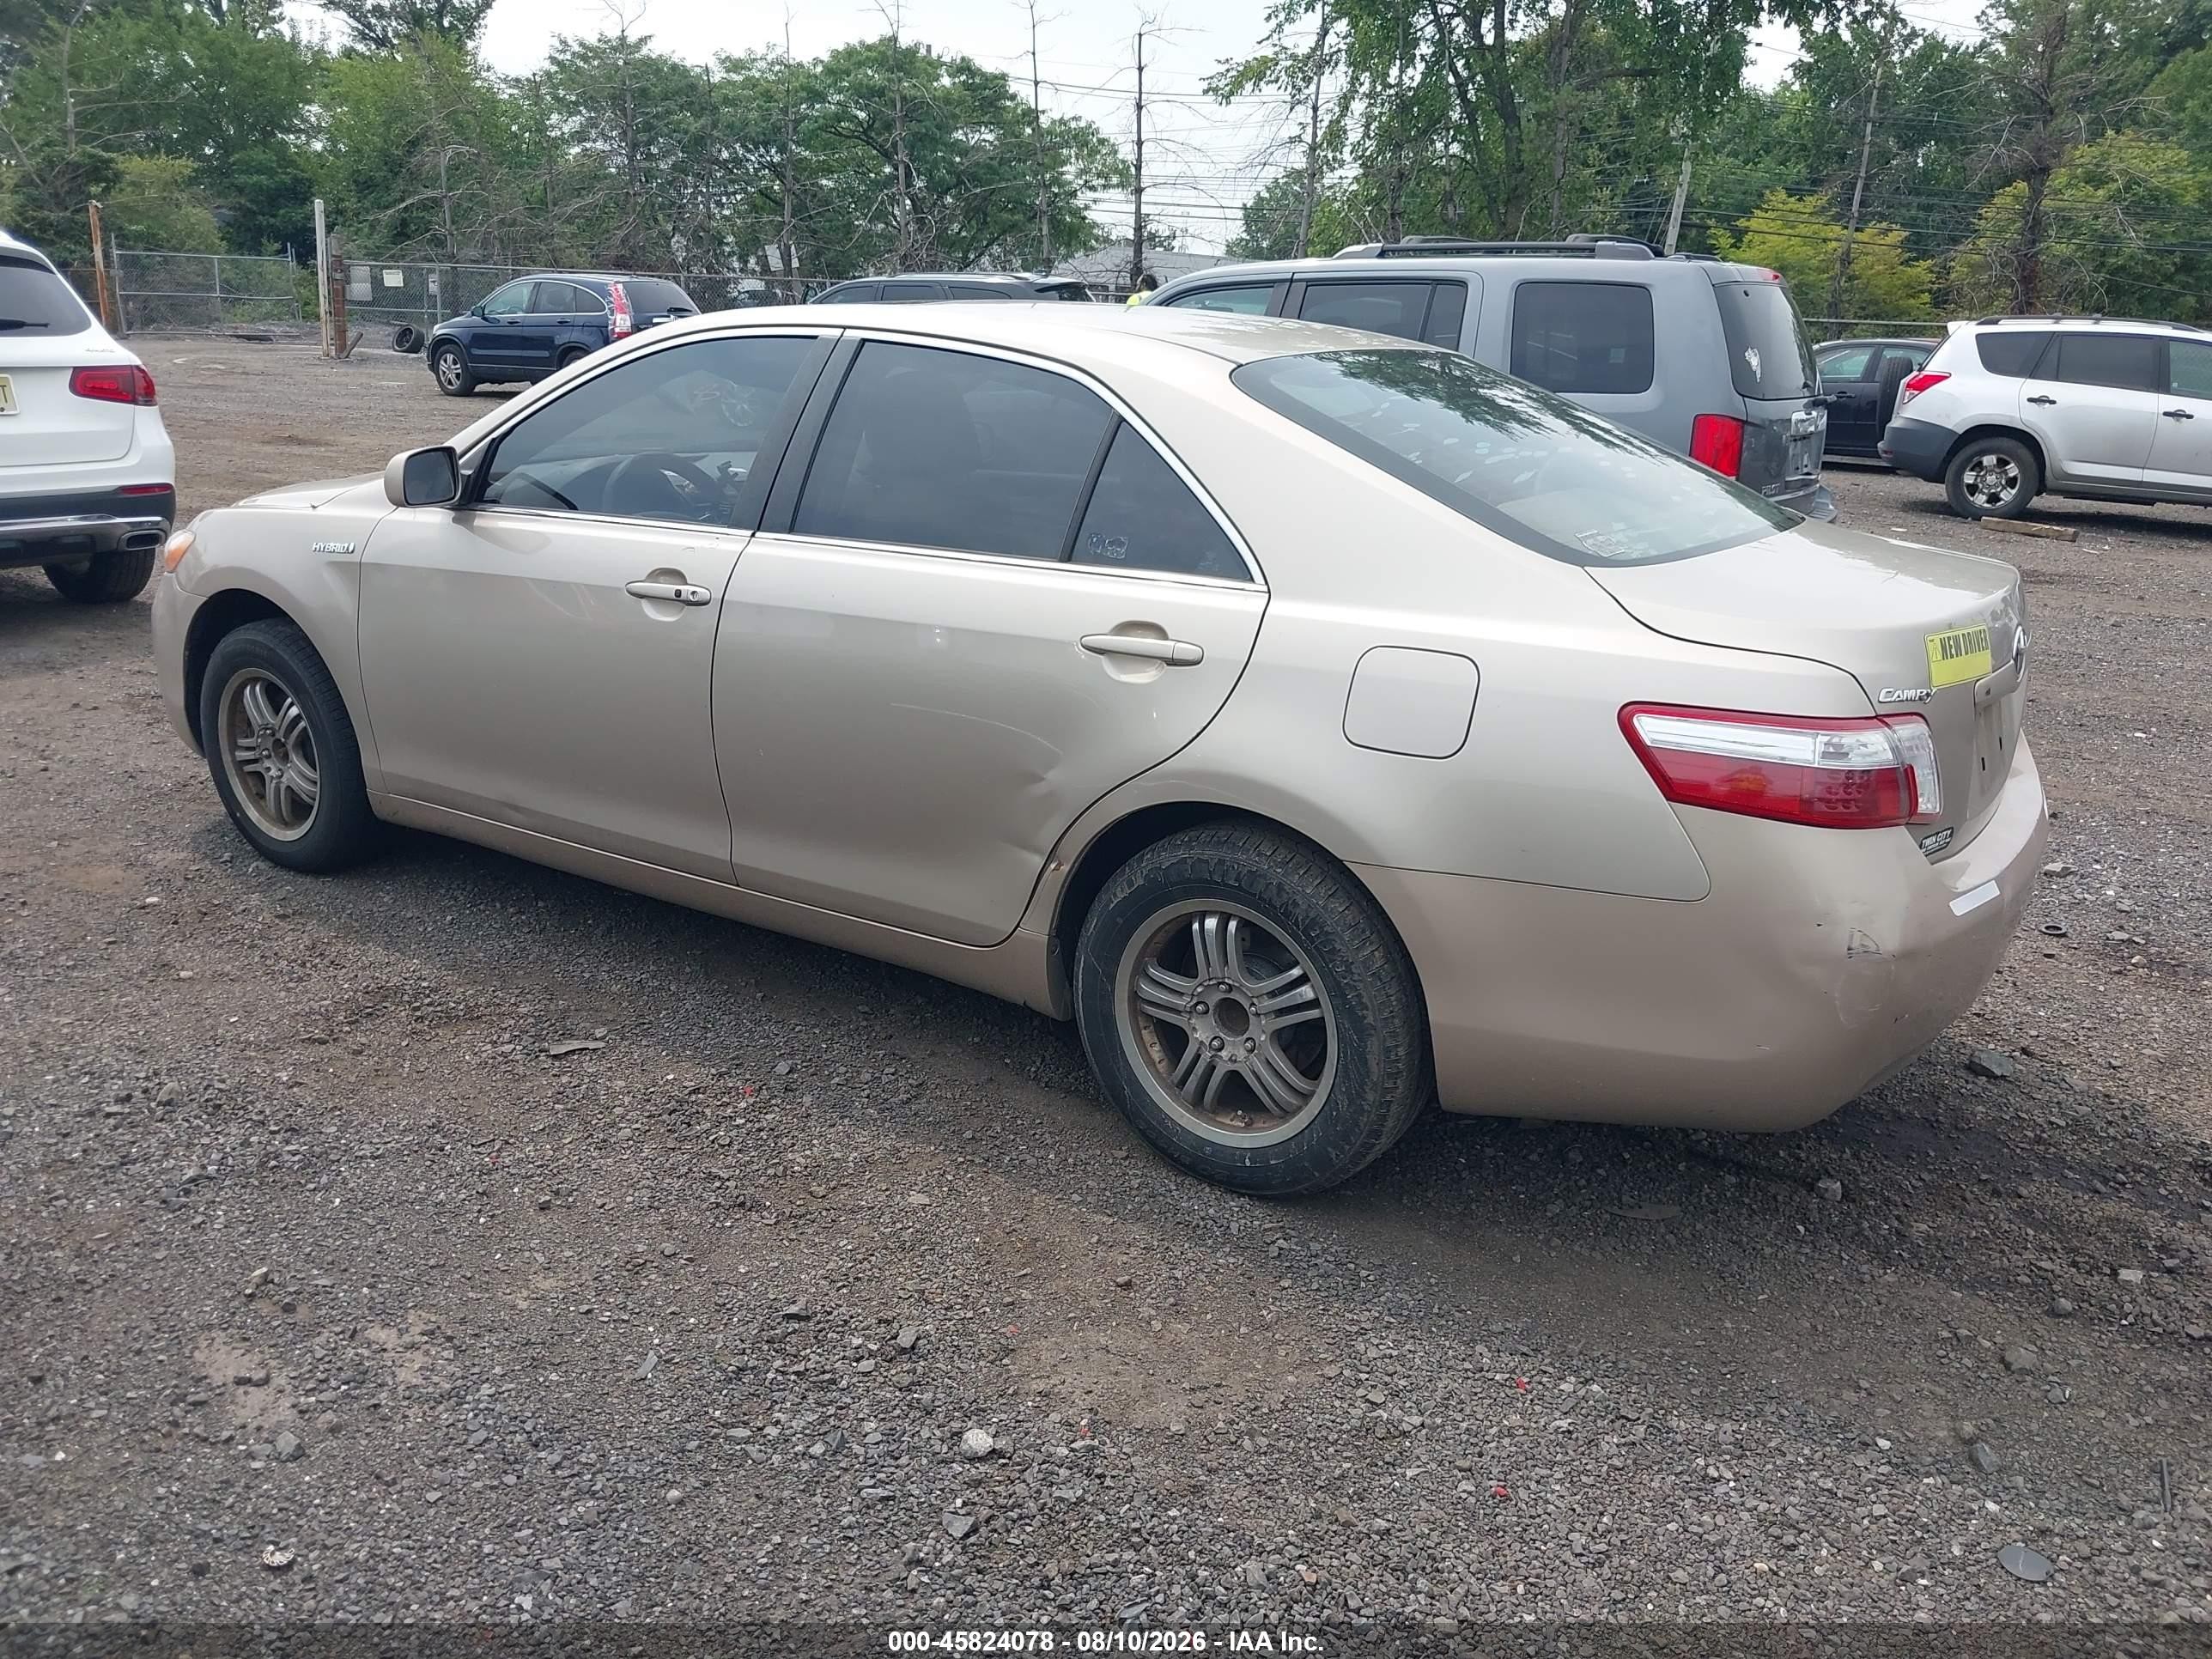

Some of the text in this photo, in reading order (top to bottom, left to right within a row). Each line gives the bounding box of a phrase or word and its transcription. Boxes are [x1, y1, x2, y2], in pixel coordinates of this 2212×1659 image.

[313, 542, 349, 553] HYBRID
[1940, 629, 1990, 660] NEW DRIVER
[1922, 835, 1937, 848] TWIN
[1937, 829, 1952, 842] CITY
